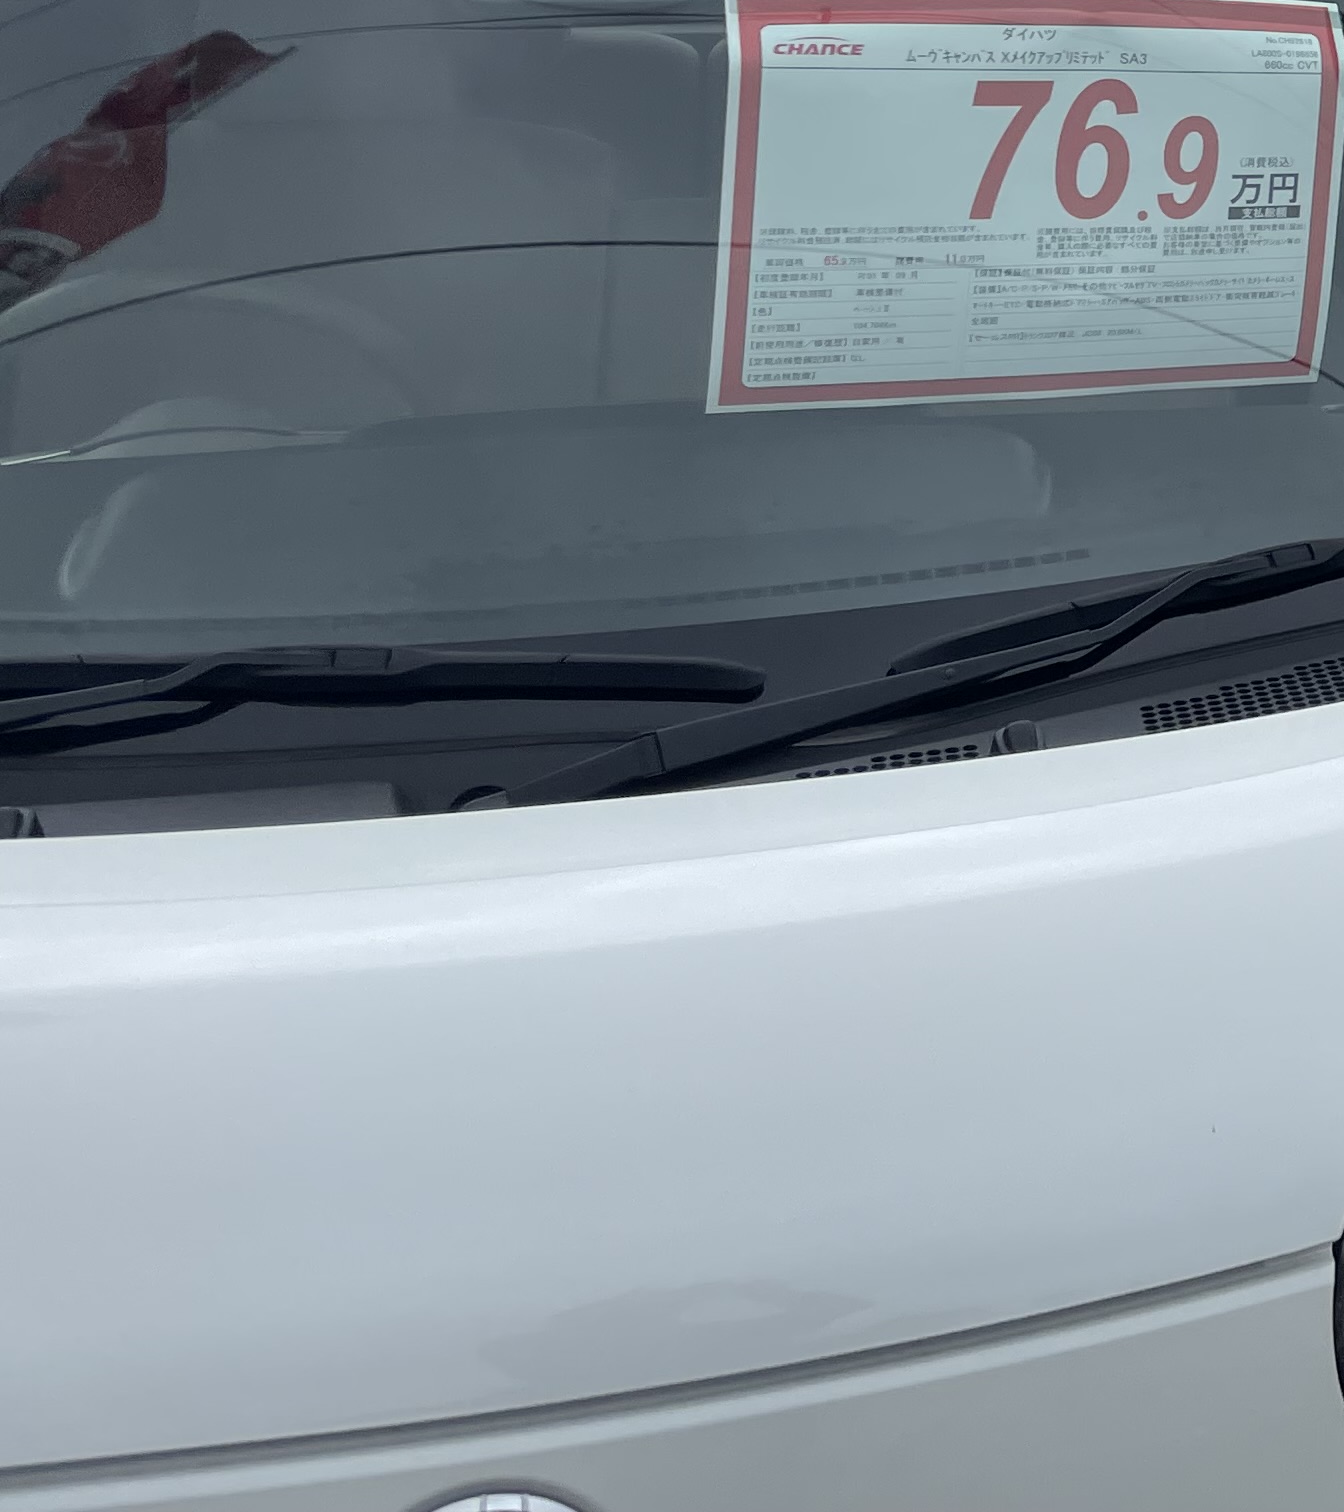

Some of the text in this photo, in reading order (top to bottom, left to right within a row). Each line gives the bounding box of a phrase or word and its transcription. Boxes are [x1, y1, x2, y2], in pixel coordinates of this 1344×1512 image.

[1002, 28, 1057, 42] ダイハツ
[773, 42, 865, 56] CHANCE
[1120, 52, 1148, 65] SA3
[969, 78, 1299, 222] 76.9 万円
